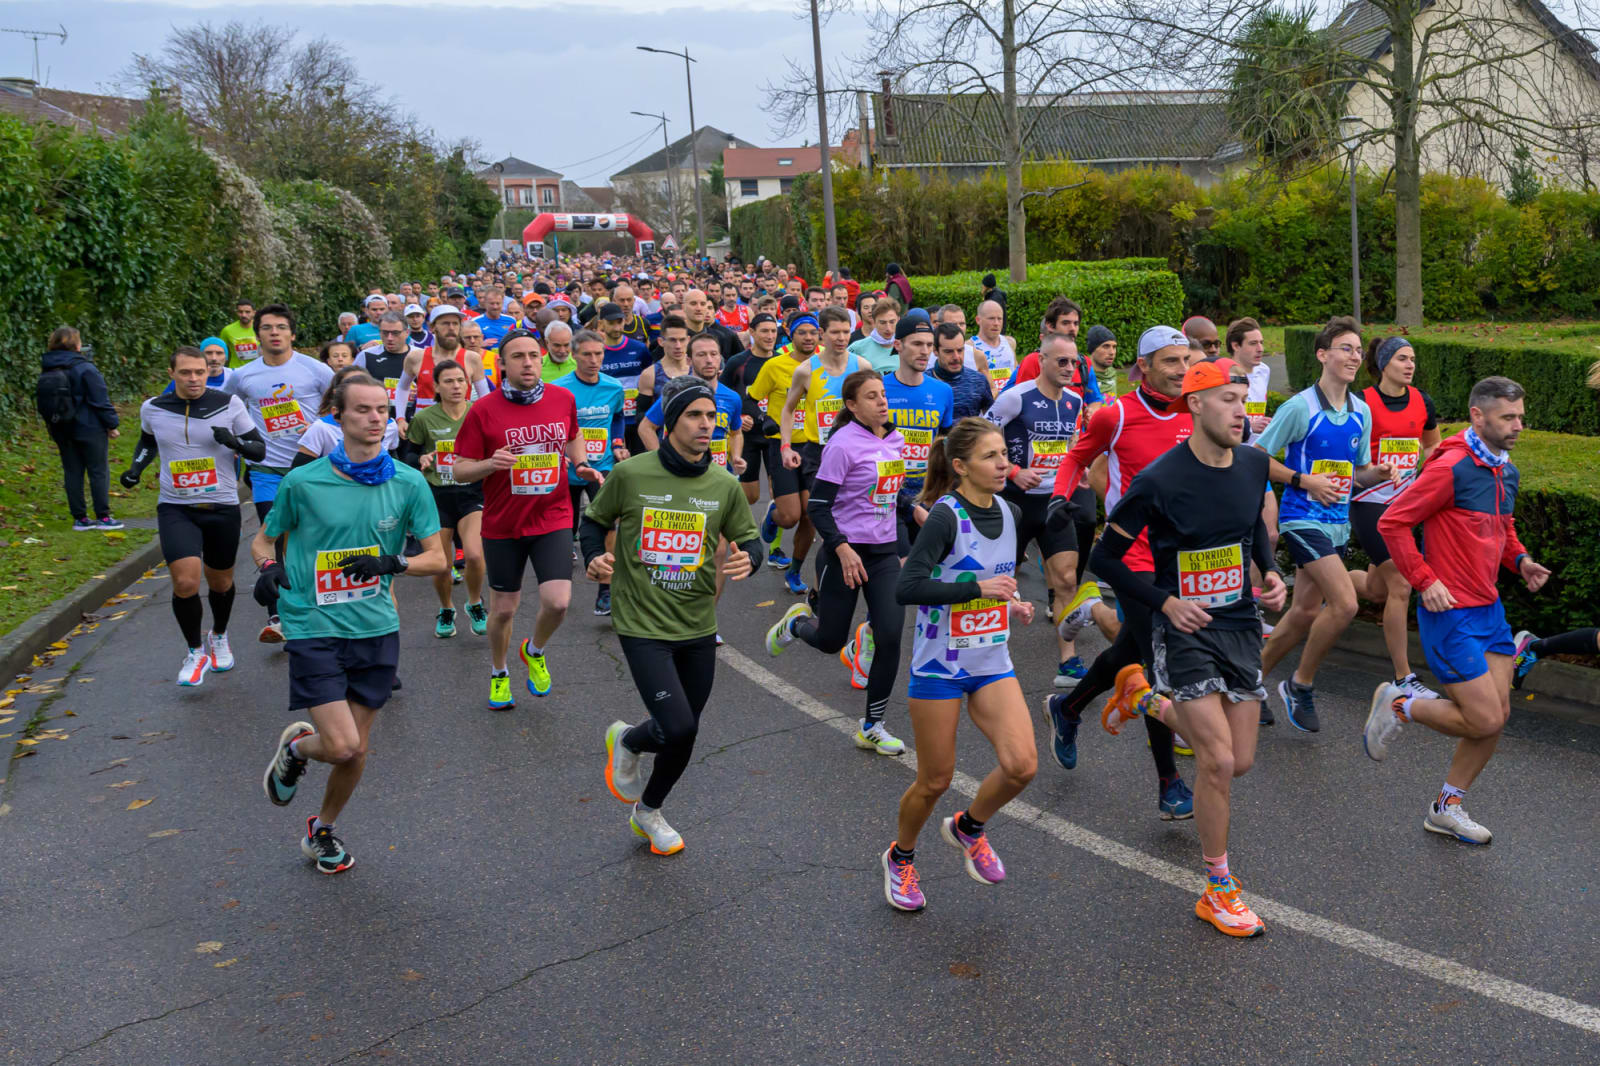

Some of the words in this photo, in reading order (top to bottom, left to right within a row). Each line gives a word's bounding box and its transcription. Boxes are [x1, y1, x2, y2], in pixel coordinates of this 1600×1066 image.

[270, 413, 299, 430] 355
[585, 440, 604, 452] 69
[902, 444, 930, 459] 330
[1381, 454, 1418, 467] 1043
[178, 472, 210, 487] 647
[519, 469, 554, 484] 167
[653, 510, 697, 523] CORRIDA
[653, 519, 664, 528] DE
[667, 521, 695, 531] THIAIS
[644, 530, 701, 551] 1509
[1188, 547, 1233, 563] CORRIDA
[1189, 561, 1201, 571] DE
[1205, 557, 1233, 570] THIAIS
[1183, 568, 1242, 594] 1828
[960, 609, 1002, 634] 622
